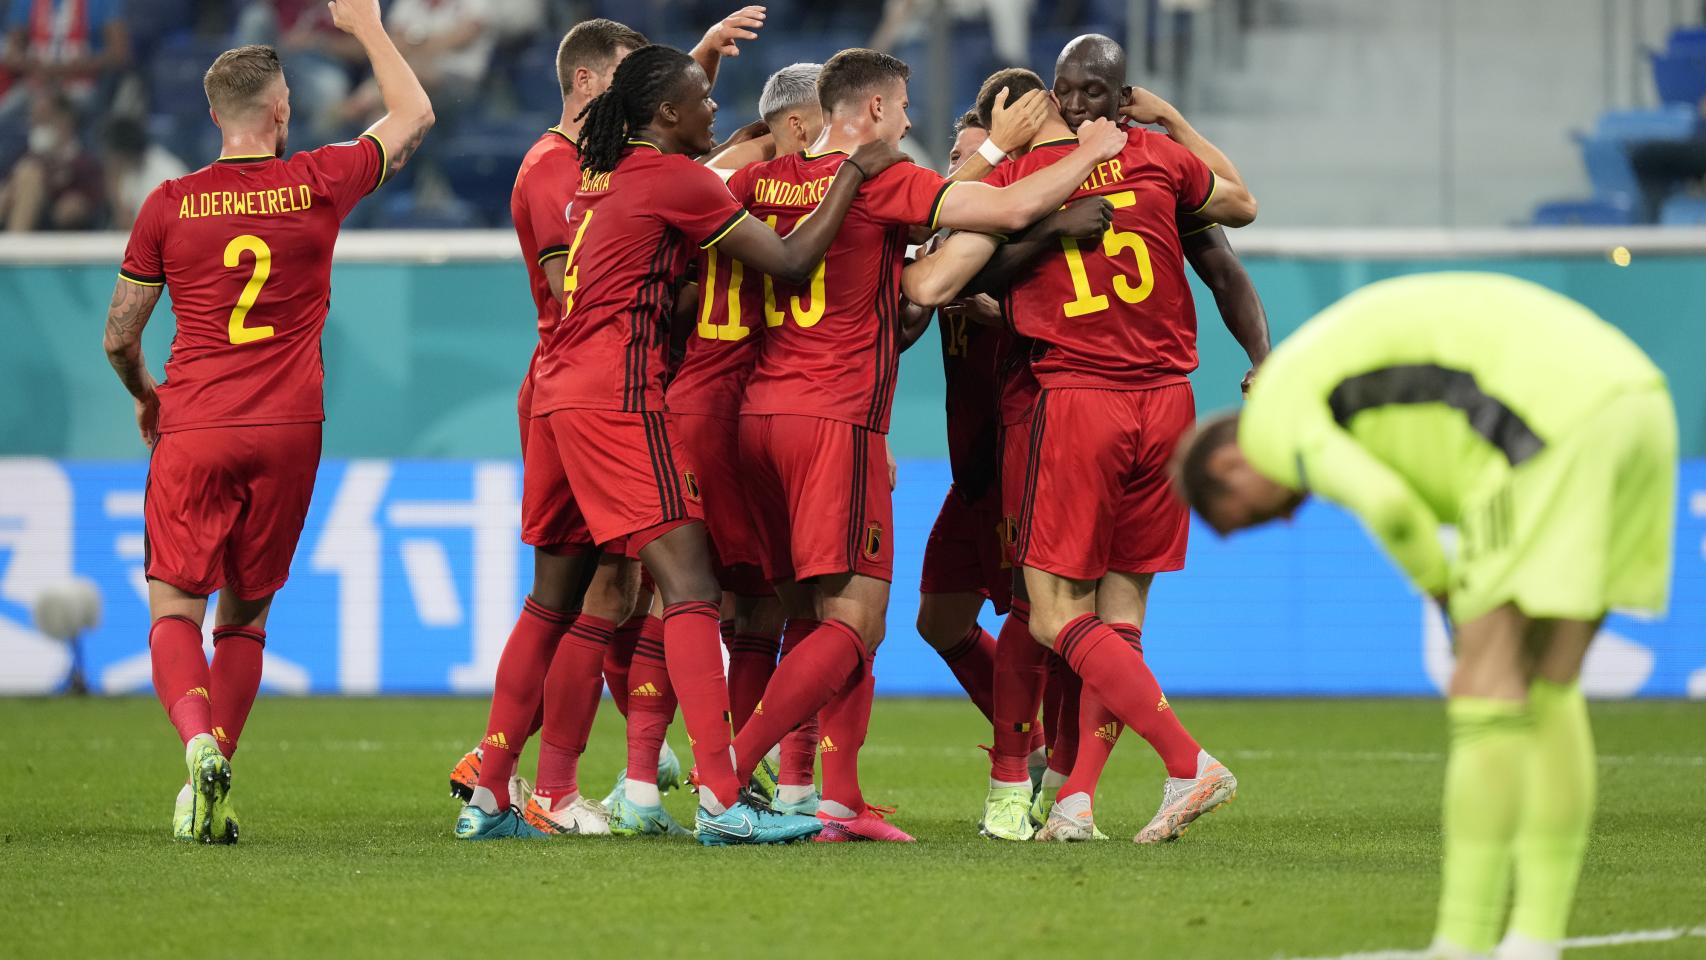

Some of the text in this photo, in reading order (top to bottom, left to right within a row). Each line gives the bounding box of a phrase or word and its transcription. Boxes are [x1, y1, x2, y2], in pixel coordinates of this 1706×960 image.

[179, 185, 311, 219] ALDERWEIRELD
[223, 234, 275, 345] 2
[1058, 190, 1154, 318] 15
[947, 313, 968, 358] 14
